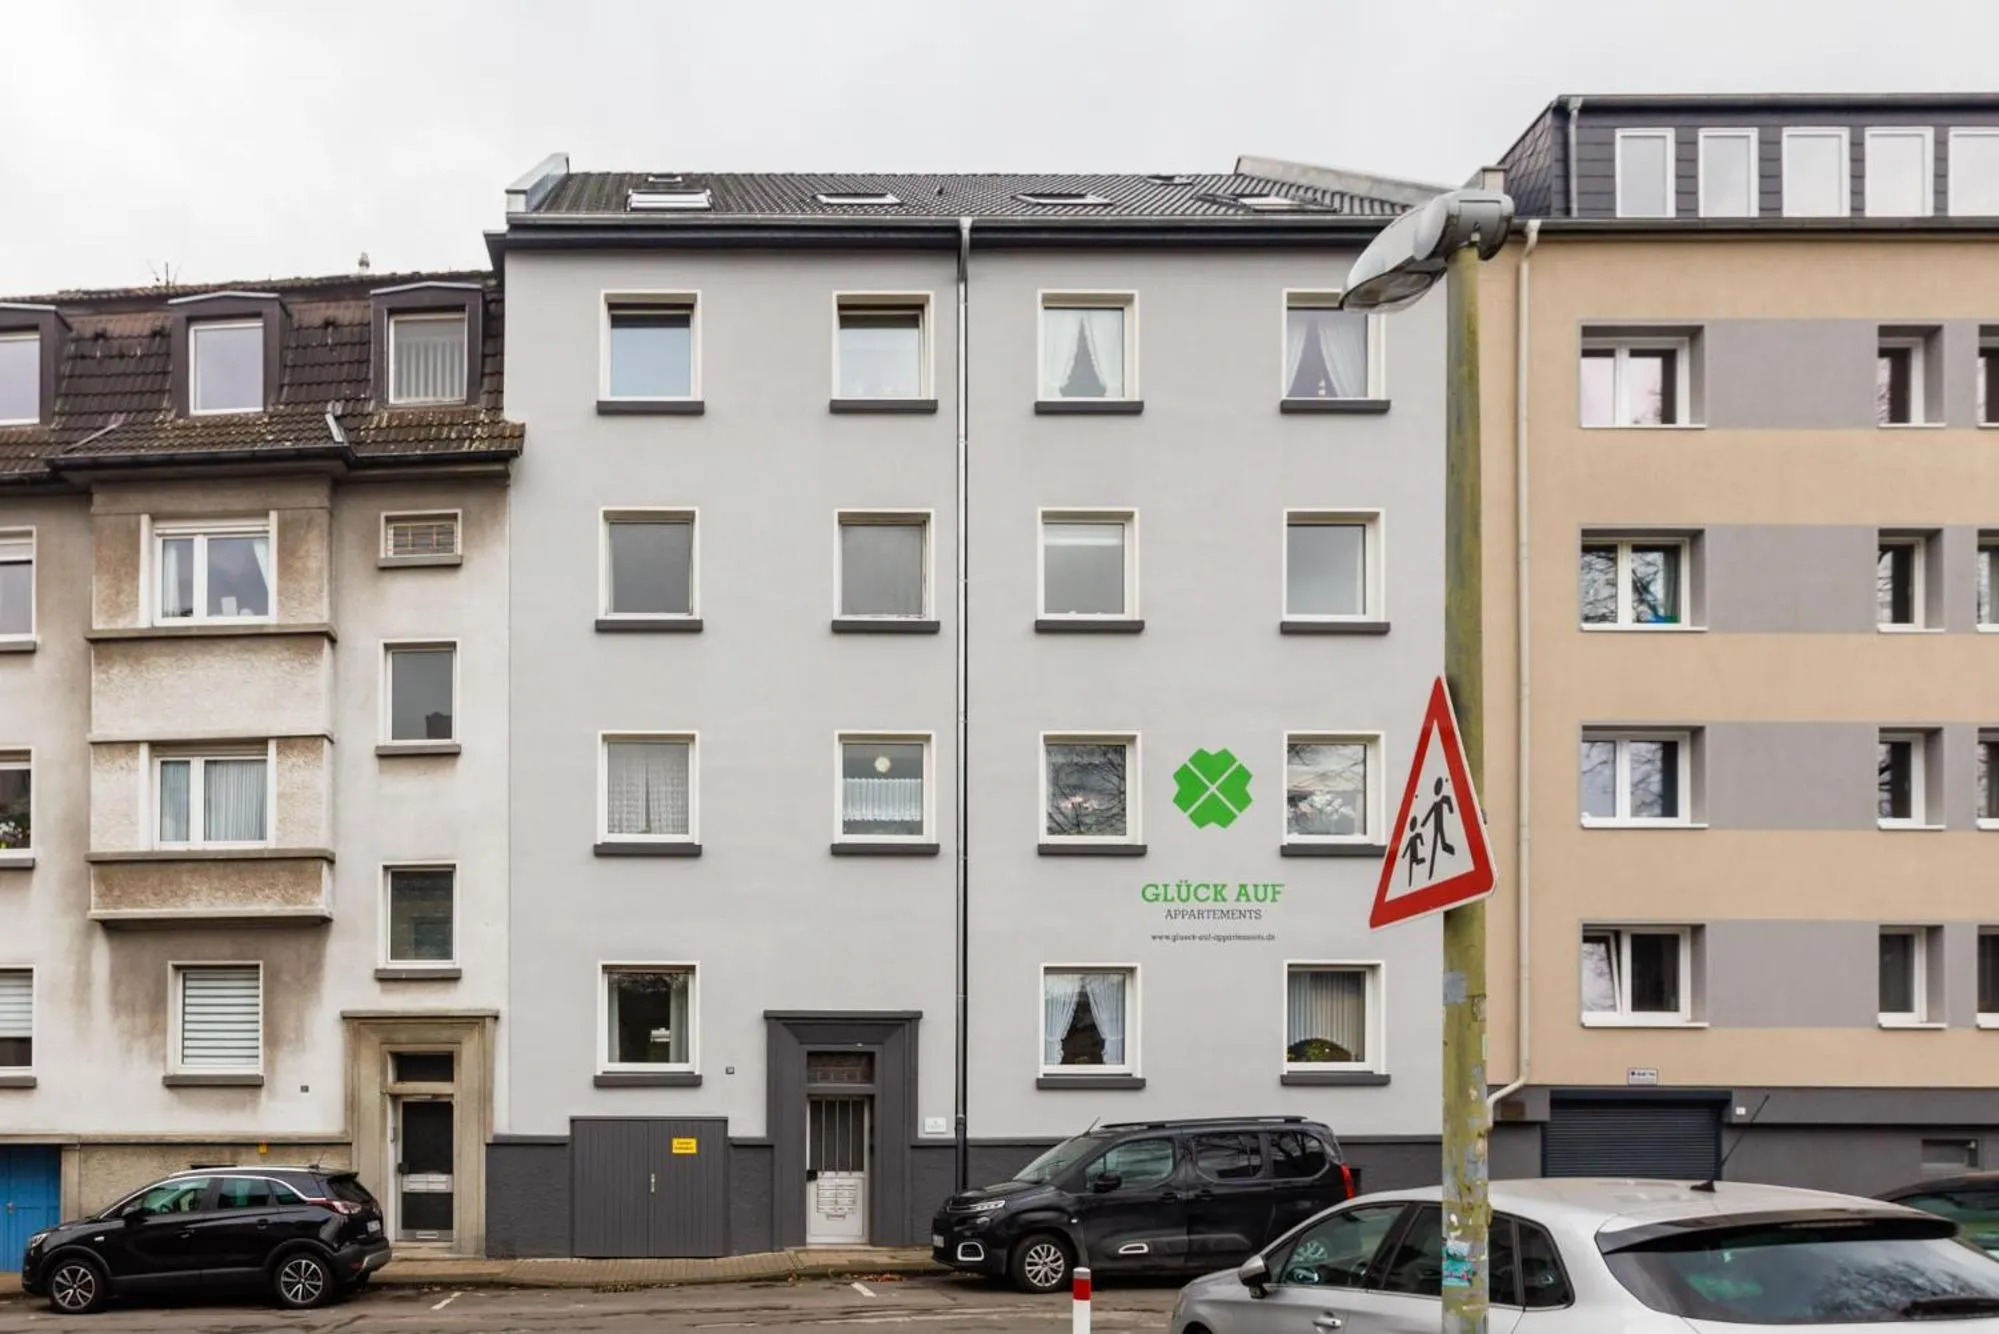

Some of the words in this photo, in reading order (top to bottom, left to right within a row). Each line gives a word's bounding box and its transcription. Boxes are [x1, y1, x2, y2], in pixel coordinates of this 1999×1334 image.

[1141, 879, 1228, 903] GLÜCK
[1234, 883, 1285, 903] AUF
[1165, 908, 1263, 920] APPARTEMENTS
